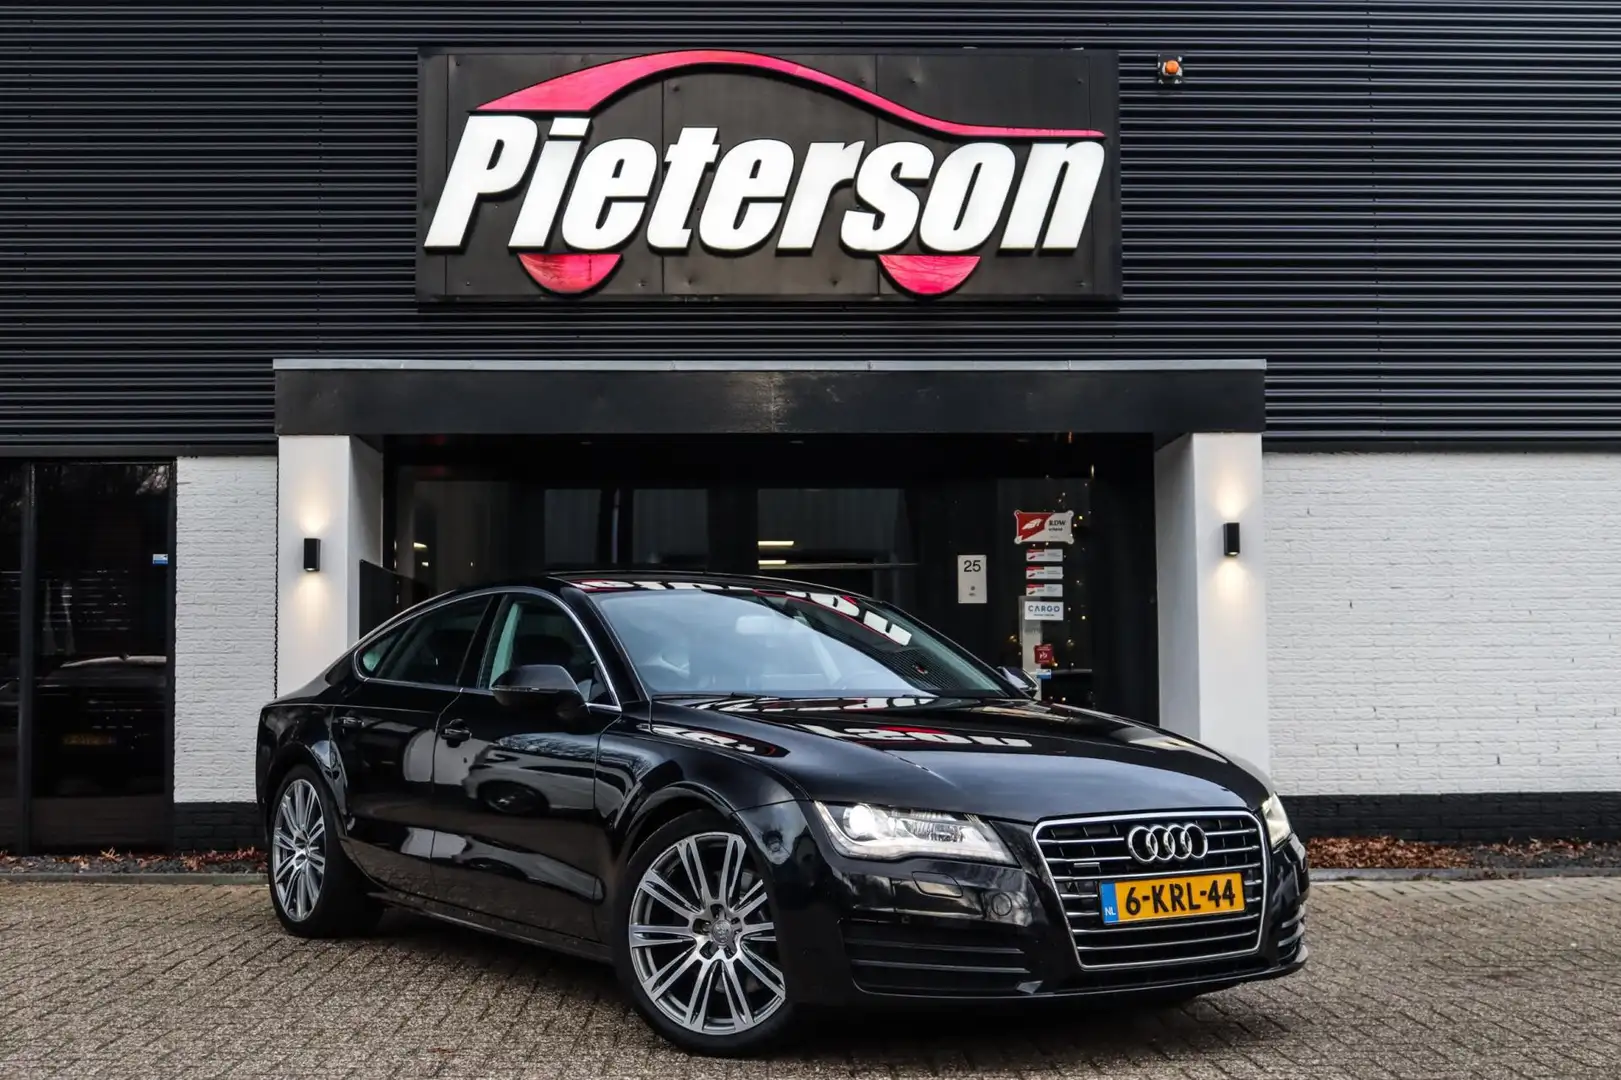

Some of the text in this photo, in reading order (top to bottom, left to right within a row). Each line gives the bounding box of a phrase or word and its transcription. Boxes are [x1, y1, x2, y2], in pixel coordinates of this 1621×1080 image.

[423, 114, 1105, 253] Pieterson
[963, 559, 981, 573] 25
[1027, 604, 1061, 613] CARGO
[1125, 878, 1236, 916] 6-KRL-44
[1104, 907, 1117, 917] NL
